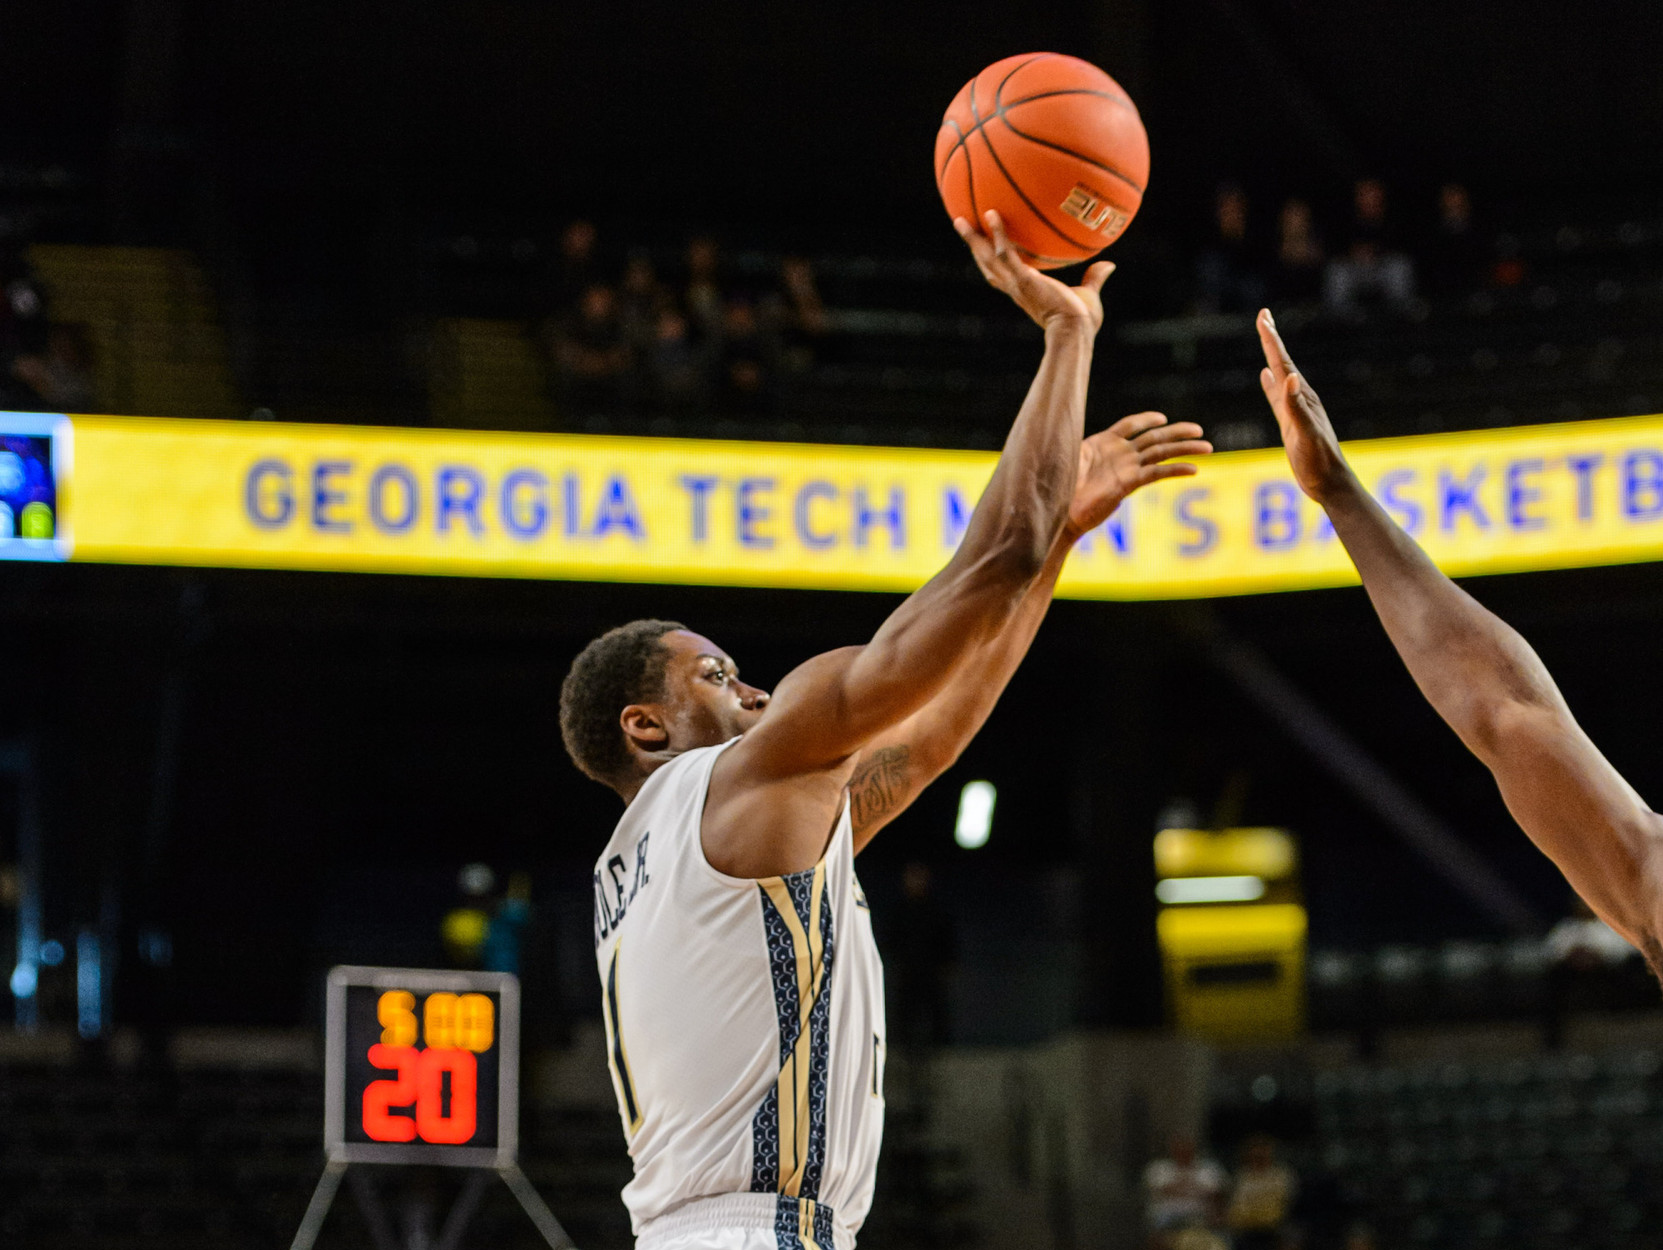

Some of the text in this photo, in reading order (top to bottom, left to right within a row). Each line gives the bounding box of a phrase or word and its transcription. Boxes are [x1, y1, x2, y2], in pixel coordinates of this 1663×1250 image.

[245, 448, 1663, 557] GEORGIA TECH MN'S BSKETB
[362, 1043, 478, 1145] 20
